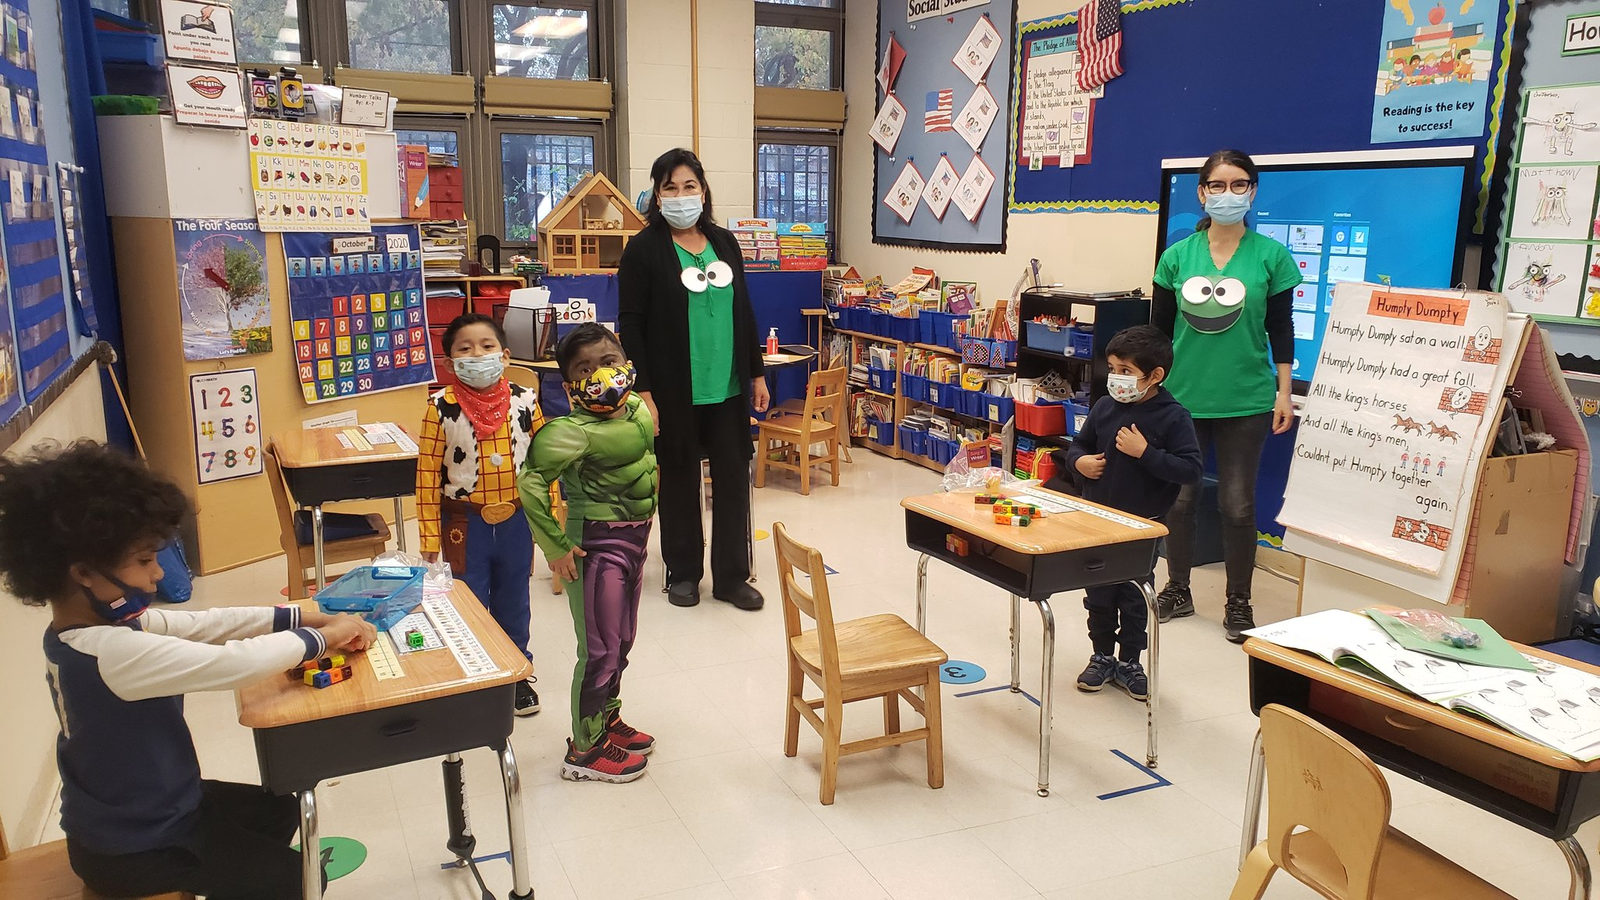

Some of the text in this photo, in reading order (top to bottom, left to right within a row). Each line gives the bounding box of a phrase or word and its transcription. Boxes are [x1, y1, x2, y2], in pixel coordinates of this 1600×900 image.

[909, 0, 939, 17] Social
[1569, 21, 1600, 42] Ho
[1043, 40, 1058, 51] Pledge
[1034, 67, 1071, 79] pledge allegiance
[1383, 101, 1475, 117] Reading is the key
[277, 122, 286, 130] Cc
[330, 127, 338, 138] Gg
[1398, 119, 1453, 133] to success!
[260, 158, 267, 167] Jj
[338, 162, 346, 171] Pp
[349, 162, 360, 173] Qq
[295, 192, 304, 200] Uu
[346, 195, 354, 205] Yy
[176, 221, 196, 231] The
[198, 220, 222, 231] Four
[388, 238, 409, 249] 2020
[339, 293, 416, 311] 1 2 3 4 5
[1377, 297, 1459, 324] Humpty Dumpty
[299, 312, 420, 336] 6 7 8 9 10 11 12
[300, 331, 421, 357] 13 14 15 16 17 18 19
[1331, 321, 1466, 350] Humpty Dumpty sat on a wall.
[301, 349, 425, 378] 20 21 22 23 24 25 26
[1321, 352, 1355, 374] Humpty
[1357, 358, 1387, 380] Dumpty
[1390, 364, 1411, 377] had
[1420, 369, 1449, 388] great
[1454, 371, 1476, 388] fall.
[322, 384, 336, 395] 28
[341, 381, 353, 393] 29
[359, 378, 371, 390] 30
[201, 385, 252, 410] 1 2 3
[1313, 384, 1408, 412] All the king's horses
[201, 415, 256, 440] 4 5 6
[1303, 414, 1409, 451] And all the king's men,
[202, 446, 256, 473] 7 8 9
[1332, 455, 1347, 471] put
[1350, 456, 1387, 482] Humpty
[1391, 466, 1432, 489] together
[1416, 495, 1451, 514] again.
